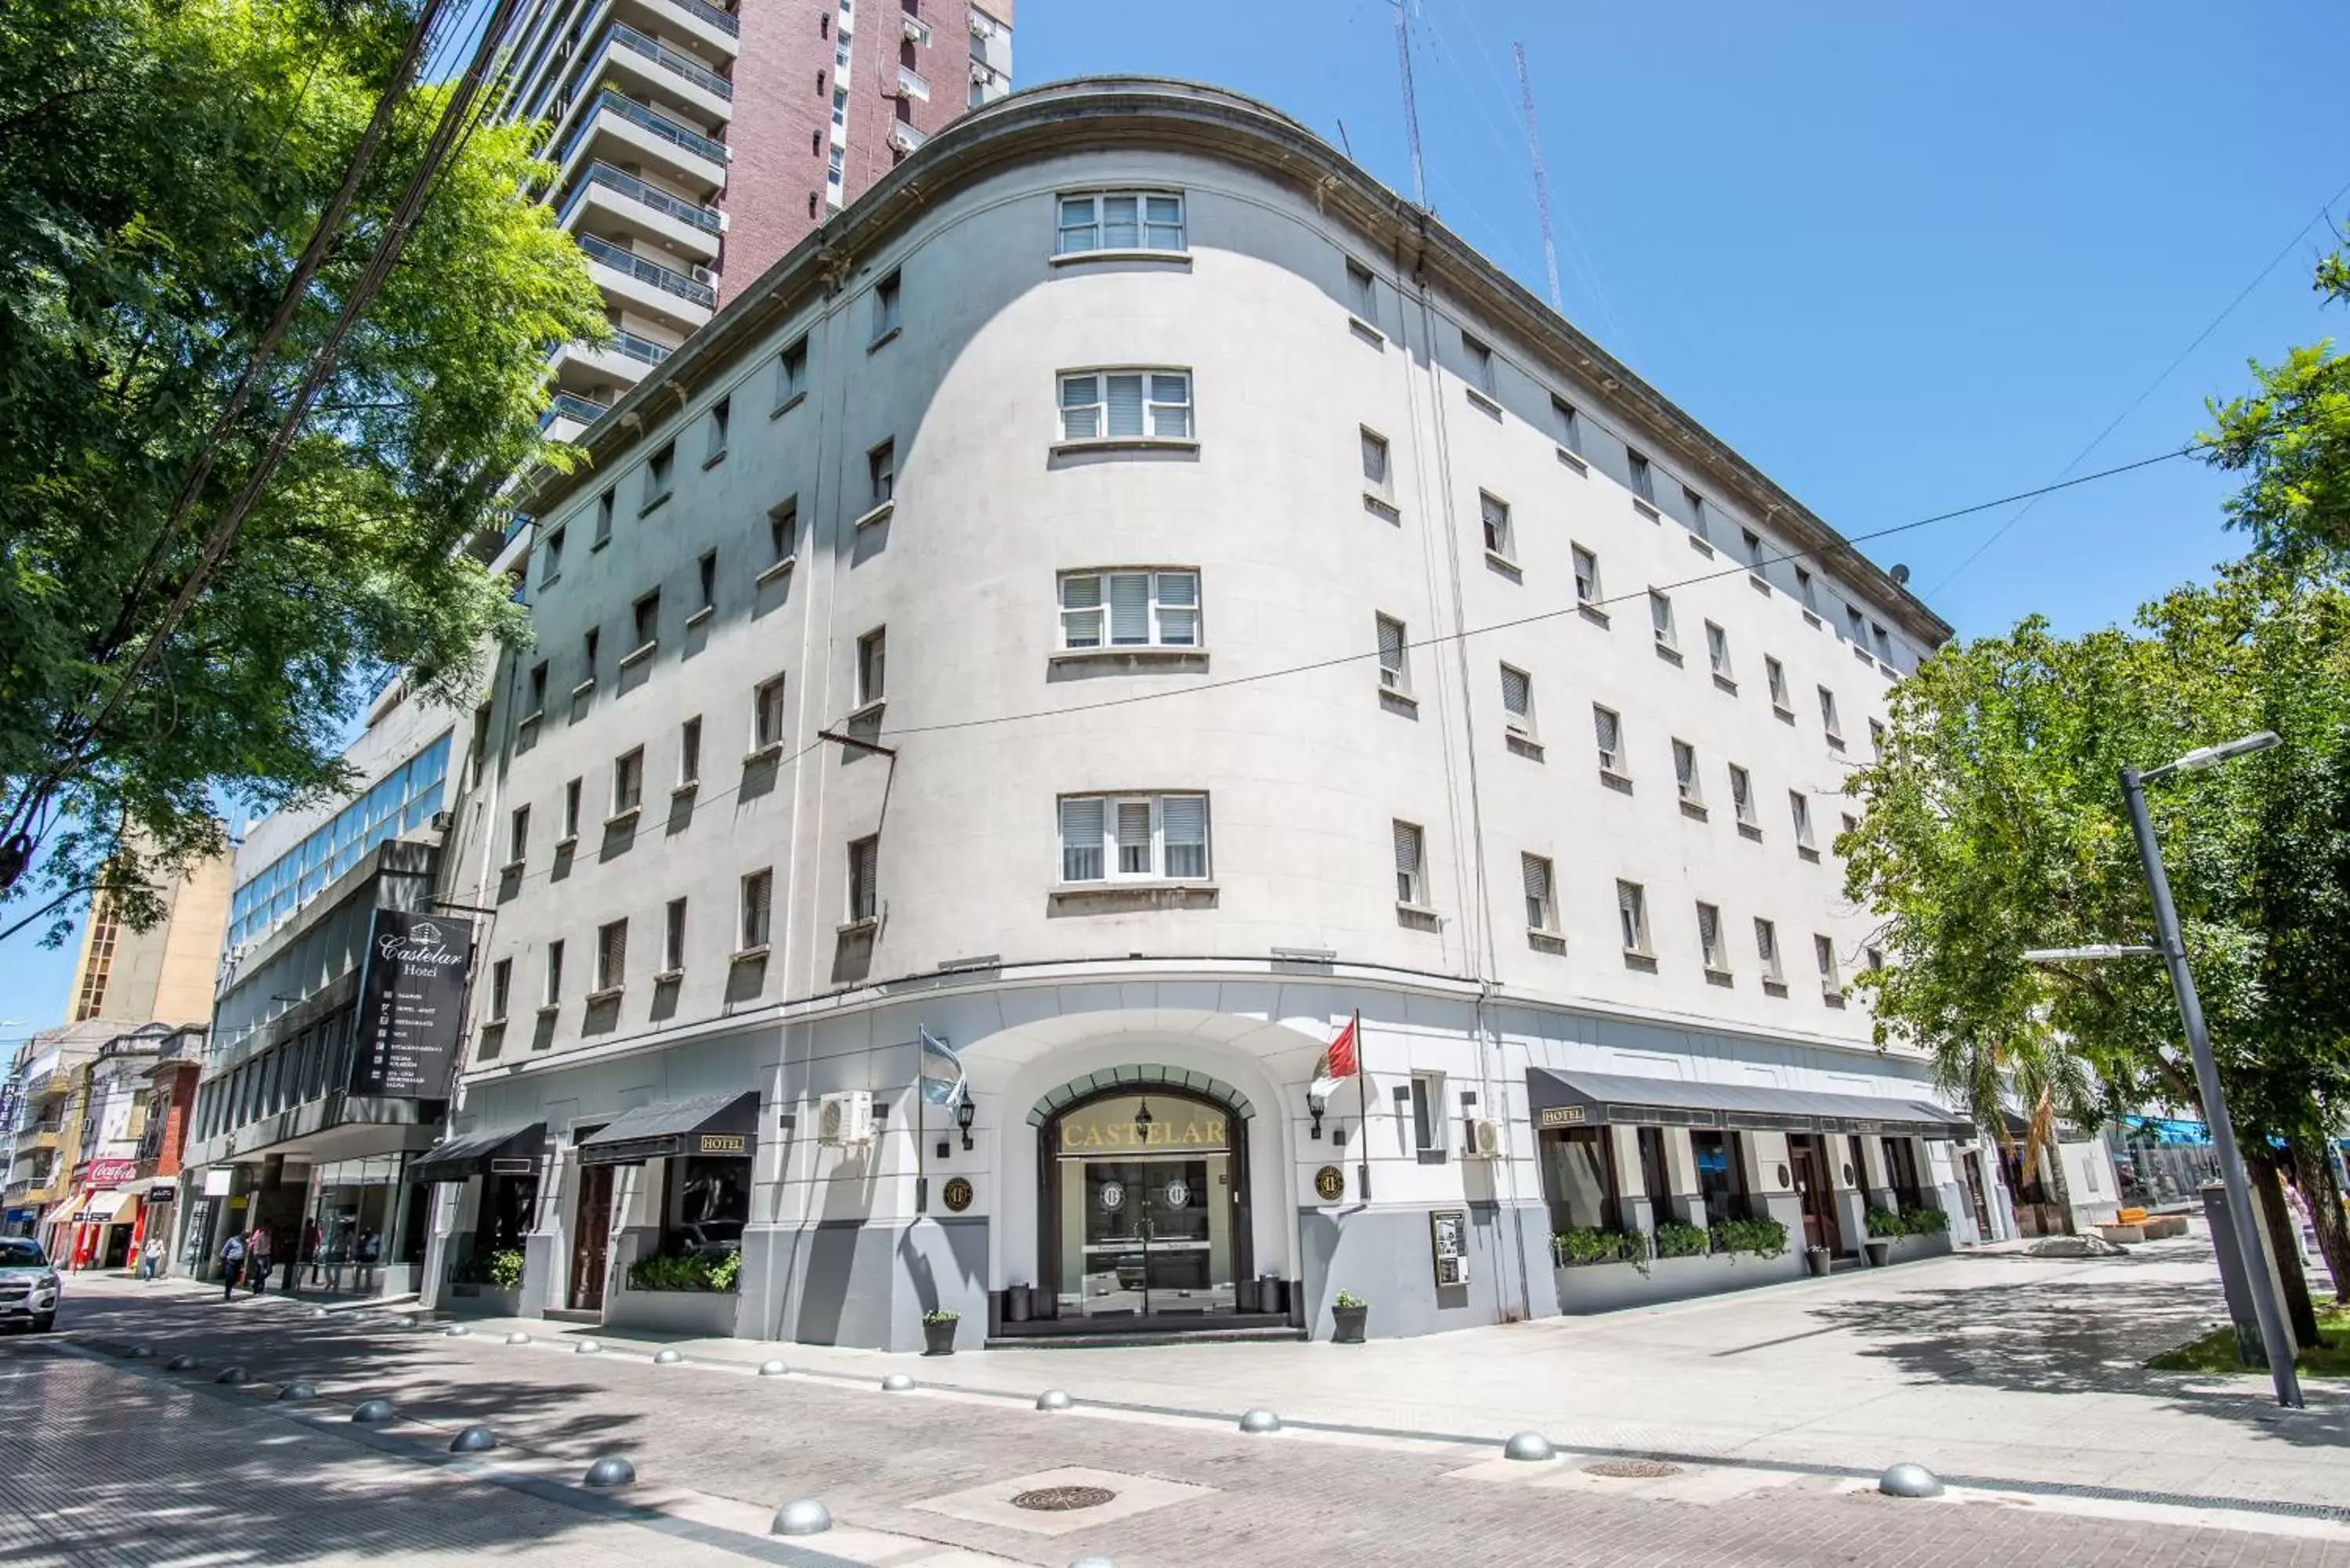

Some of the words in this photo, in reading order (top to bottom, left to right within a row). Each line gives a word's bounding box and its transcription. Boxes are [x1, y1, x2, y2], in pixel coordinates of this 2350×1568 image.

[378, 933, 463, 965] Castelar
[403, 963, 437, 977] Hotel
[1546, 1108, 1582, 1121] HOTEL
[1063, 1121, 1224, 1147] CASTELAR
[704, 1138, 743, 1149] HOTEL
